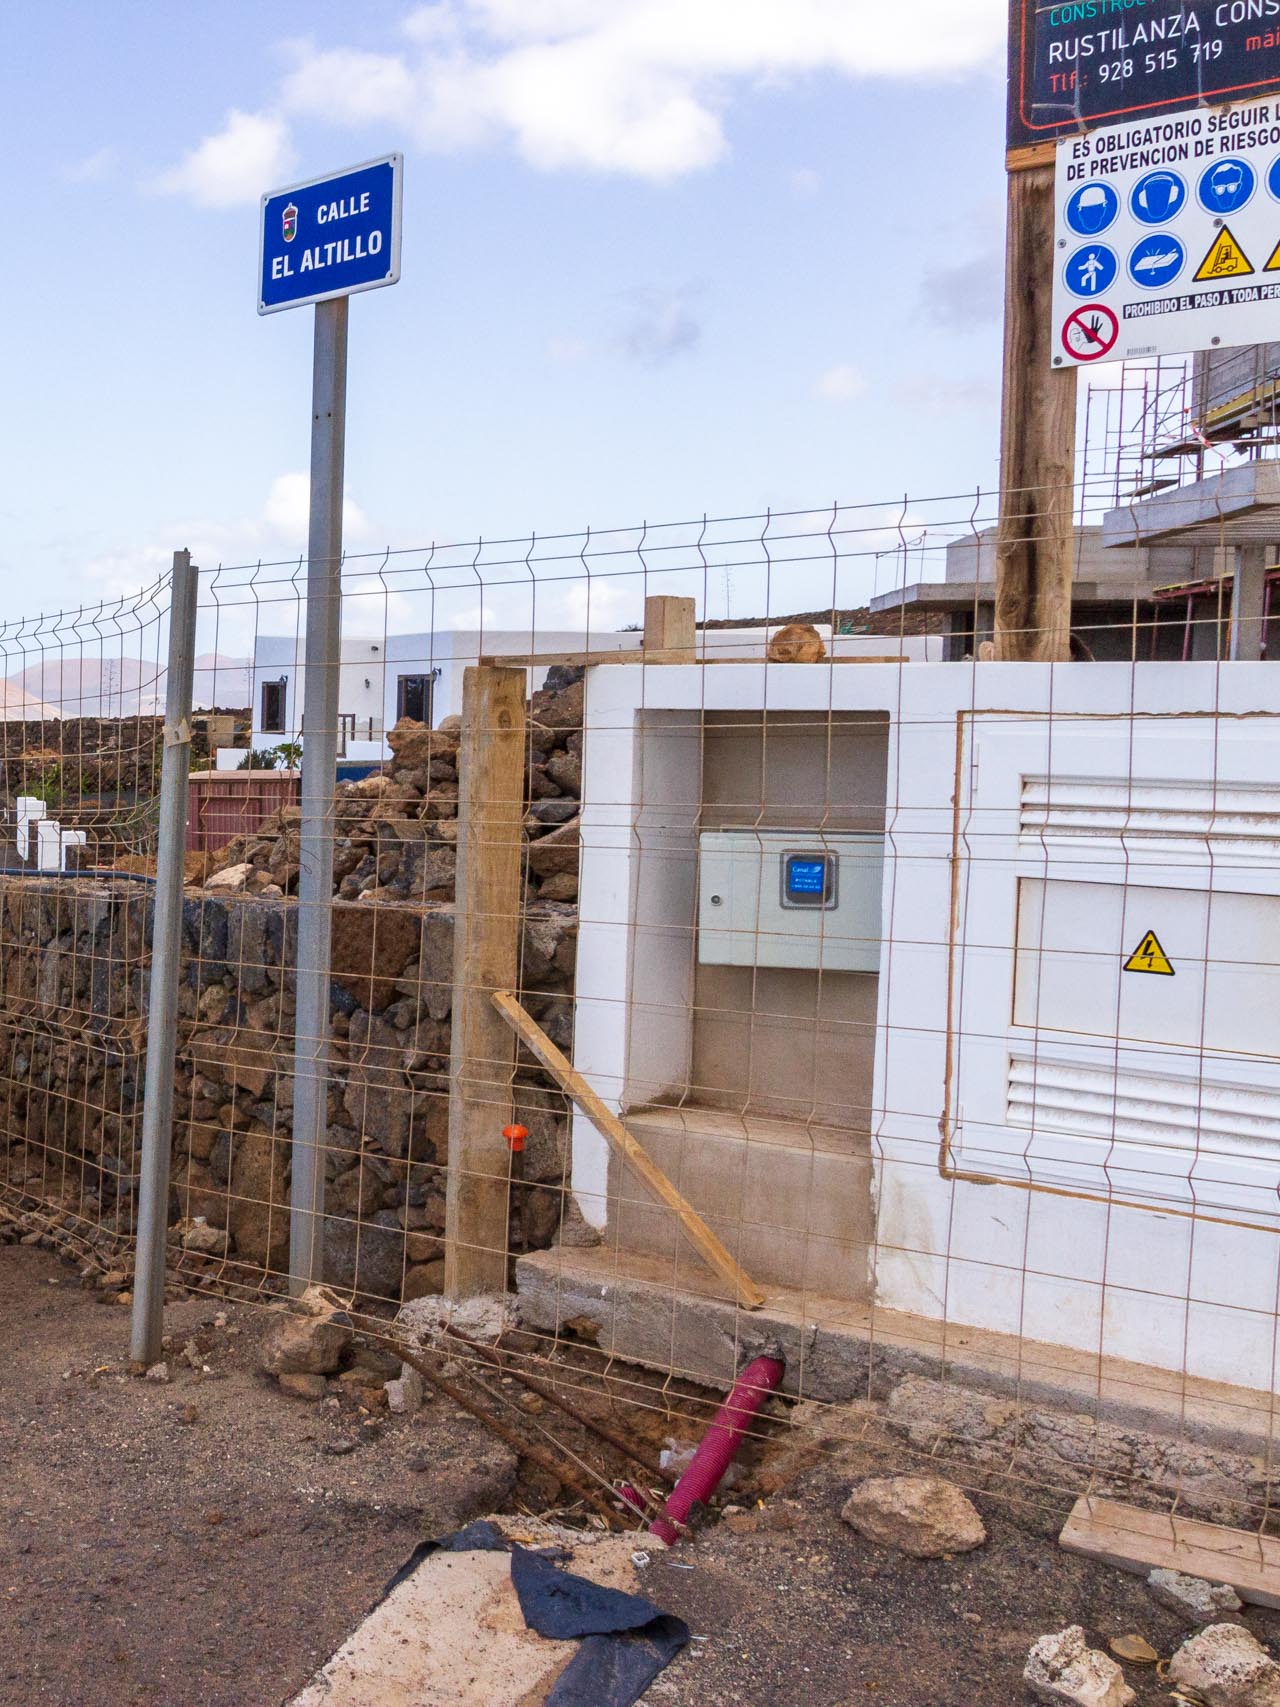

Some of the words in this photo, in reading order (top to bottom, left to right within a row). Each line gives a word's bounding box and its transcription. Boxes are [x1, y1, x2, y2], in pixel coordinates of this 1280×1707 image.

[1049, 11, 1200, 64] RUSTILANZA
[1216, 0, 1280, 26] CONS
[1050, 0, 1156, 26] CONSTR
[1099, 59, 1133, 83] 928
[1145, 49, 1177, 73] 515
[1190, 39, 1222, 63] 719
[1067, 163, 1085, 181] DE
[1091, 143, 1188, 176] PREVENCION
[1195, 138, 1214, 157] DE
[1220, 126, 1280, 153] RIESGO
[1073, 141, 1090, 159] ES
[1096, 119, 1201, 154] OBLIGATORIO
[1208, 106, 1269, 133] SEGUIR
[317, 192, 370, 225] CALLE
[272, 255, 294, 280] EL
[300, 230, 382, 273] ALTILLO
[1125, 299, 1177, 318] PROHIBIDO
[1180, 297, 1192, 310] EL
[1195, 293, 1220, 308] PASO
[1222, 292, 1229, 304] A
[1232, 288, 1258, 303] TODA
